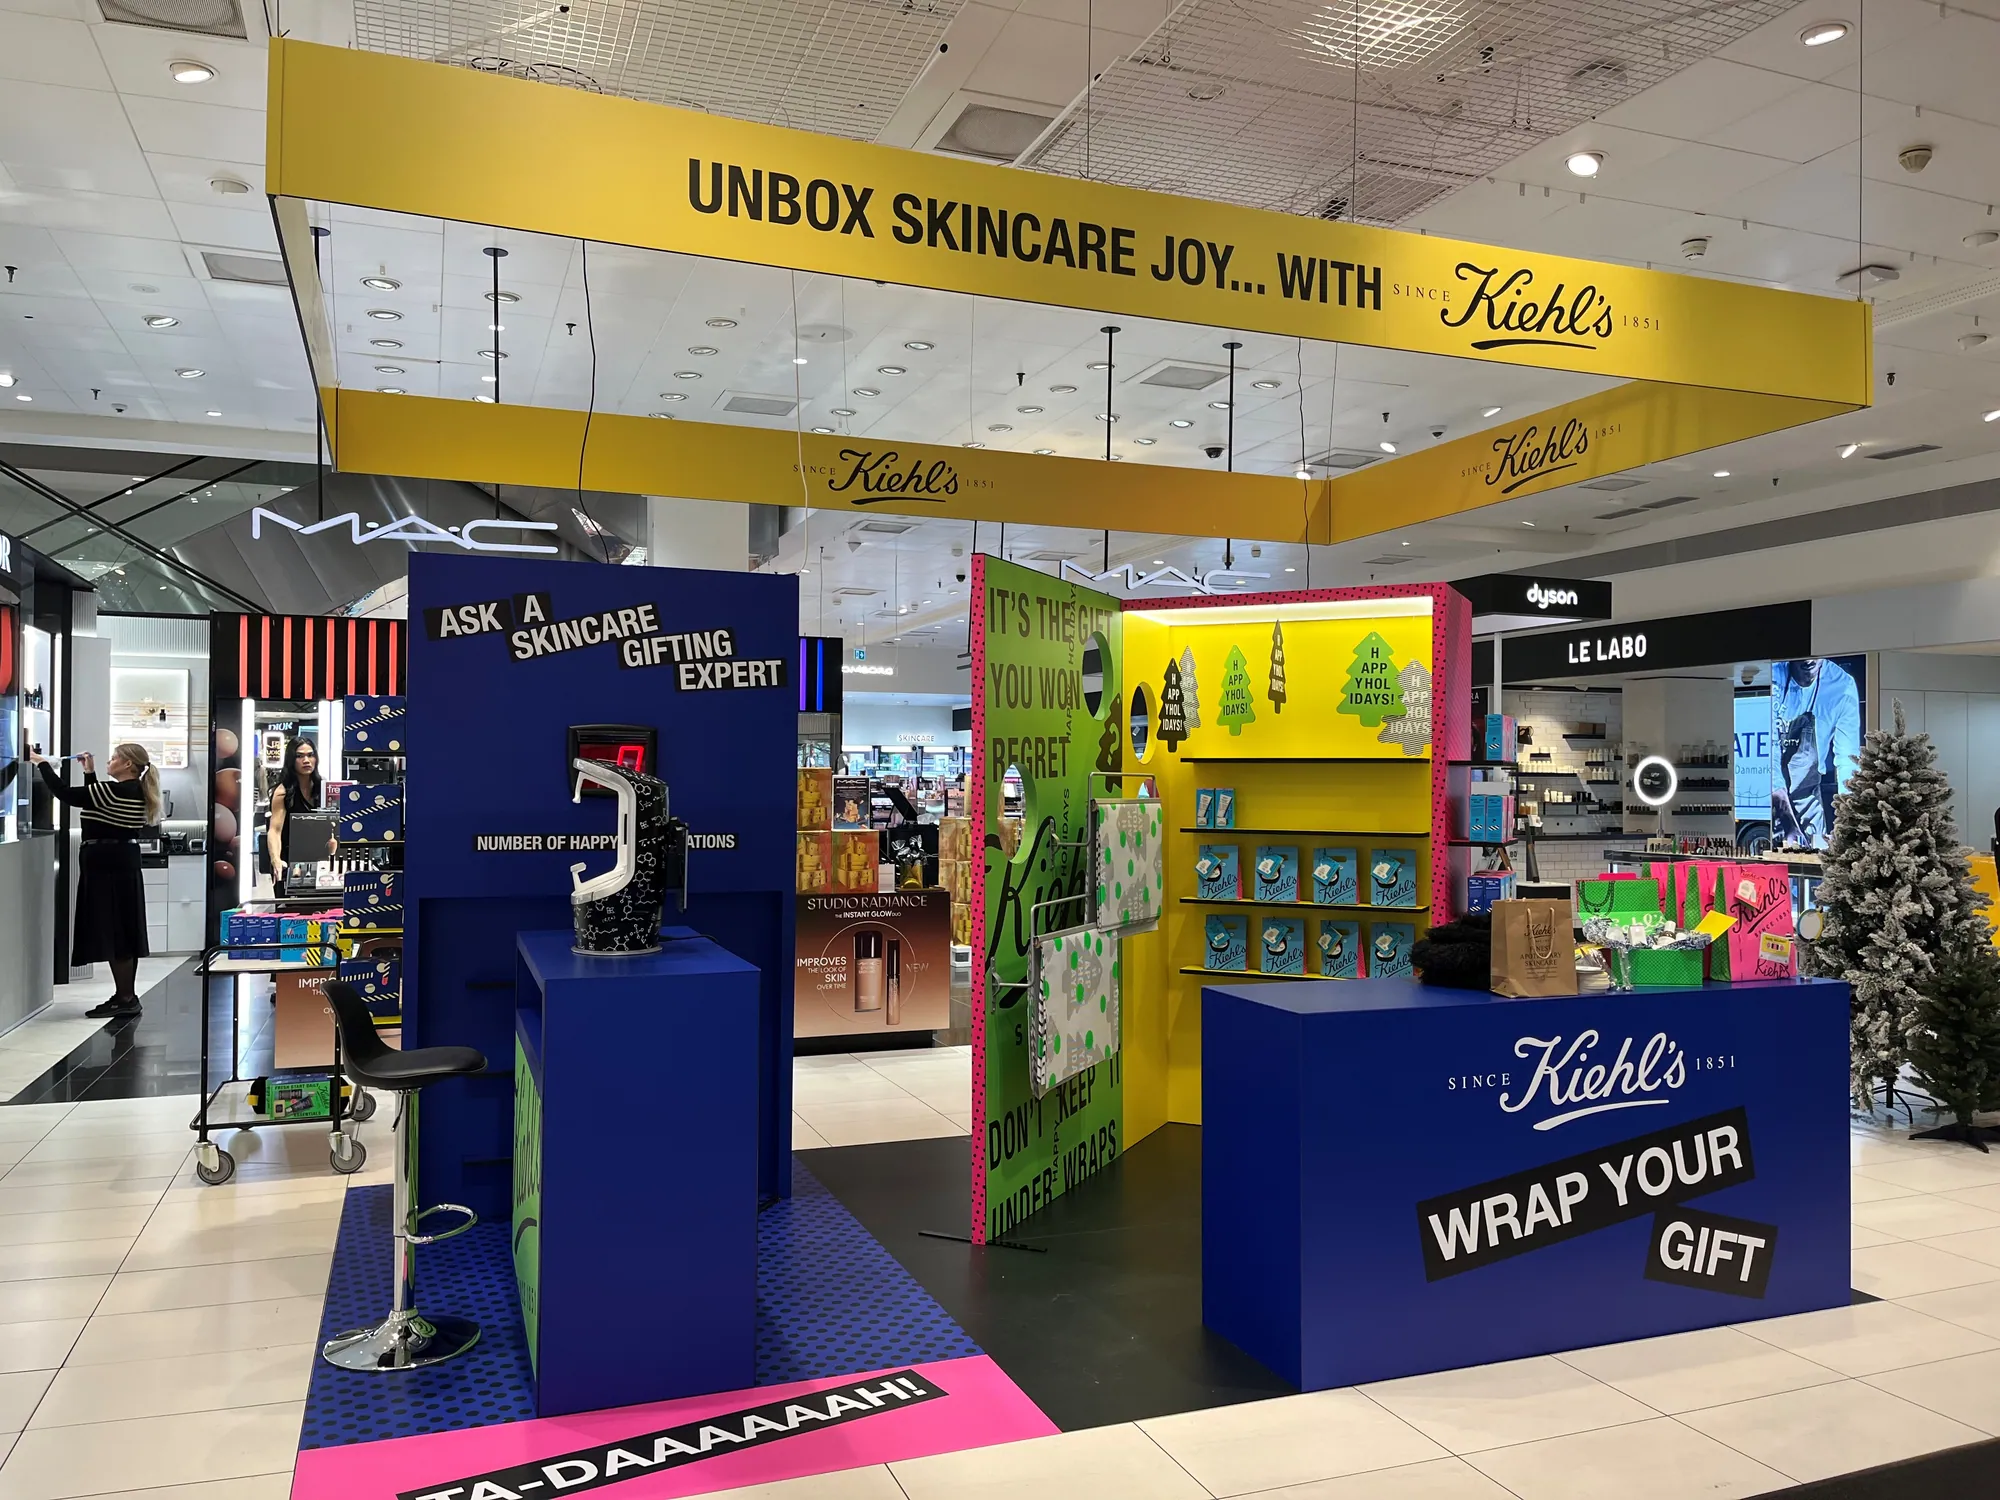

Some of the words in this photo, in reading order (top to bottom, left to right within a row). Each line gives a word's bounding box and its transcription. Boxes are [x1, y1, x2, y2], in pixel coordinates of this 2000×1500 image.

[687, 158, 875, 239] UNBOX
[891, 192, 1136, 278] SKINCARE
[1150, 235, 1266, 296] JOY...
[1276, 252, 1382, 311] WITH
[1392, 282, 1451, 303] SINCE
[1440, 261, 1613, 339] Kiehl's
[1622, 314, 1661, 332] 1851
[1460, 463, 1492, 478] SINCE
[1484, 417, 1589, 487] Kiehl's
[1594, 423, 1622, 440] 1851
[792, 464, 836, 476] SINCE
[827, 448, 959, 495] Kiehl's
[965, 478, 995, 489] 1851
[1526, 582, 1579, 609] dyson
[439, 602, 504, 638] ASK
[523, 594, 546, 623] A
[989, 587, 1031, 638] IT'S
[1036, 595, 1072, 643] THE
[510, 603, 659, 660] SKINCARE
[622, 629, 733, 668] GIFTING
[1370, 647, 1379, 659] H
[1568, 640, 1591, 664] LE
[1596, 634, 1648, 661] LABO
[679, 659, 782, 691] EXPERT
[1233, 659, 1239, 671] H
[1361, 662, 1388, 674] APP
[989, 662, 1033, 710] YOU
[1038, 666, 1081, 711] WON
[1171, 673, 1177, 685] H
[1228, 673, 1244, 686] APP
[1355, 677, 1391, 690] YHOL
[1411, 674, 1420, 687] H
[1167, 688, 1180, 701] APP
[1225, 688, 1246, 701] YHOL
[1349, 692, 1395, 705] IDAYS!
[1401, 690, 1428, 704] APP
[1164, 703, 1182, 716] YHOL
[1223, 702, 1248, 717] IDAYS!
[1162, 718, 1183, 732] IDAYS!
[1390, 721, 1430, 734] IDAYS
[898, 734, 935, 742] SKINCARE
[991, 735, 1070, 783] REGRET
[1735, 764, 1771, 777] Danmark
[476, 835, 543, 852] NUMBER
[546, 835, 567, 851] OF
[569, 834, 619, 850] HAPPY
[687, 834, 736, 850] ATIONS
[982, 814, 1087, 977] Kieh
[1201, 873, 1238, 898] Kiehl's
[1259, 875, 1297, 900] Kiehl's
[1318, 877, 1357, 903] Kiehl's
[1375, 879, 1417, 906] Kiehl's
[807, 897, 859, 911] STUDIO
[861, 894, 928, 909] RADIANCE
[843, 911, 871, 919] INSTANT
[871, 910, 892, 918] GLOW
[796, 956, 847, 967] IMPROVES
[905, 962, 929, 973] NEW
[1209, 944, 1247, 969] Kiehl's
[1265, 947, 1304, 973] Kiehl's
[1324, 951, 1358, 976] Kiehl's
[1374, 954, 1409, 979] Kiehl
[816, 983, 833, 991] OVER
[833, 982, 847, 990] TIME
[824, 973, 847, 983] SKIN
[1447, 1072, 1512, 1090] SINCE
[1499, 1028, 1687, 1113] Kiehl's
[1694, 1055, 1737, 1071] 1851
[987, 1096, 1044, 1172] DON'T
[1057, 1064, 1096, 1124] KEEP
[1051, 1119, 1061, 1183] HAPPY
[990, 1165, 1053, 1244] UNDER
[1062, 1118, 1117, 1193] WRAPS
[1428, 1170, 1589, 1261] WRAP
[1598, 1125, 1744, 1207] YOUR
[1658, 1220, 1767, 1282] GIFT
